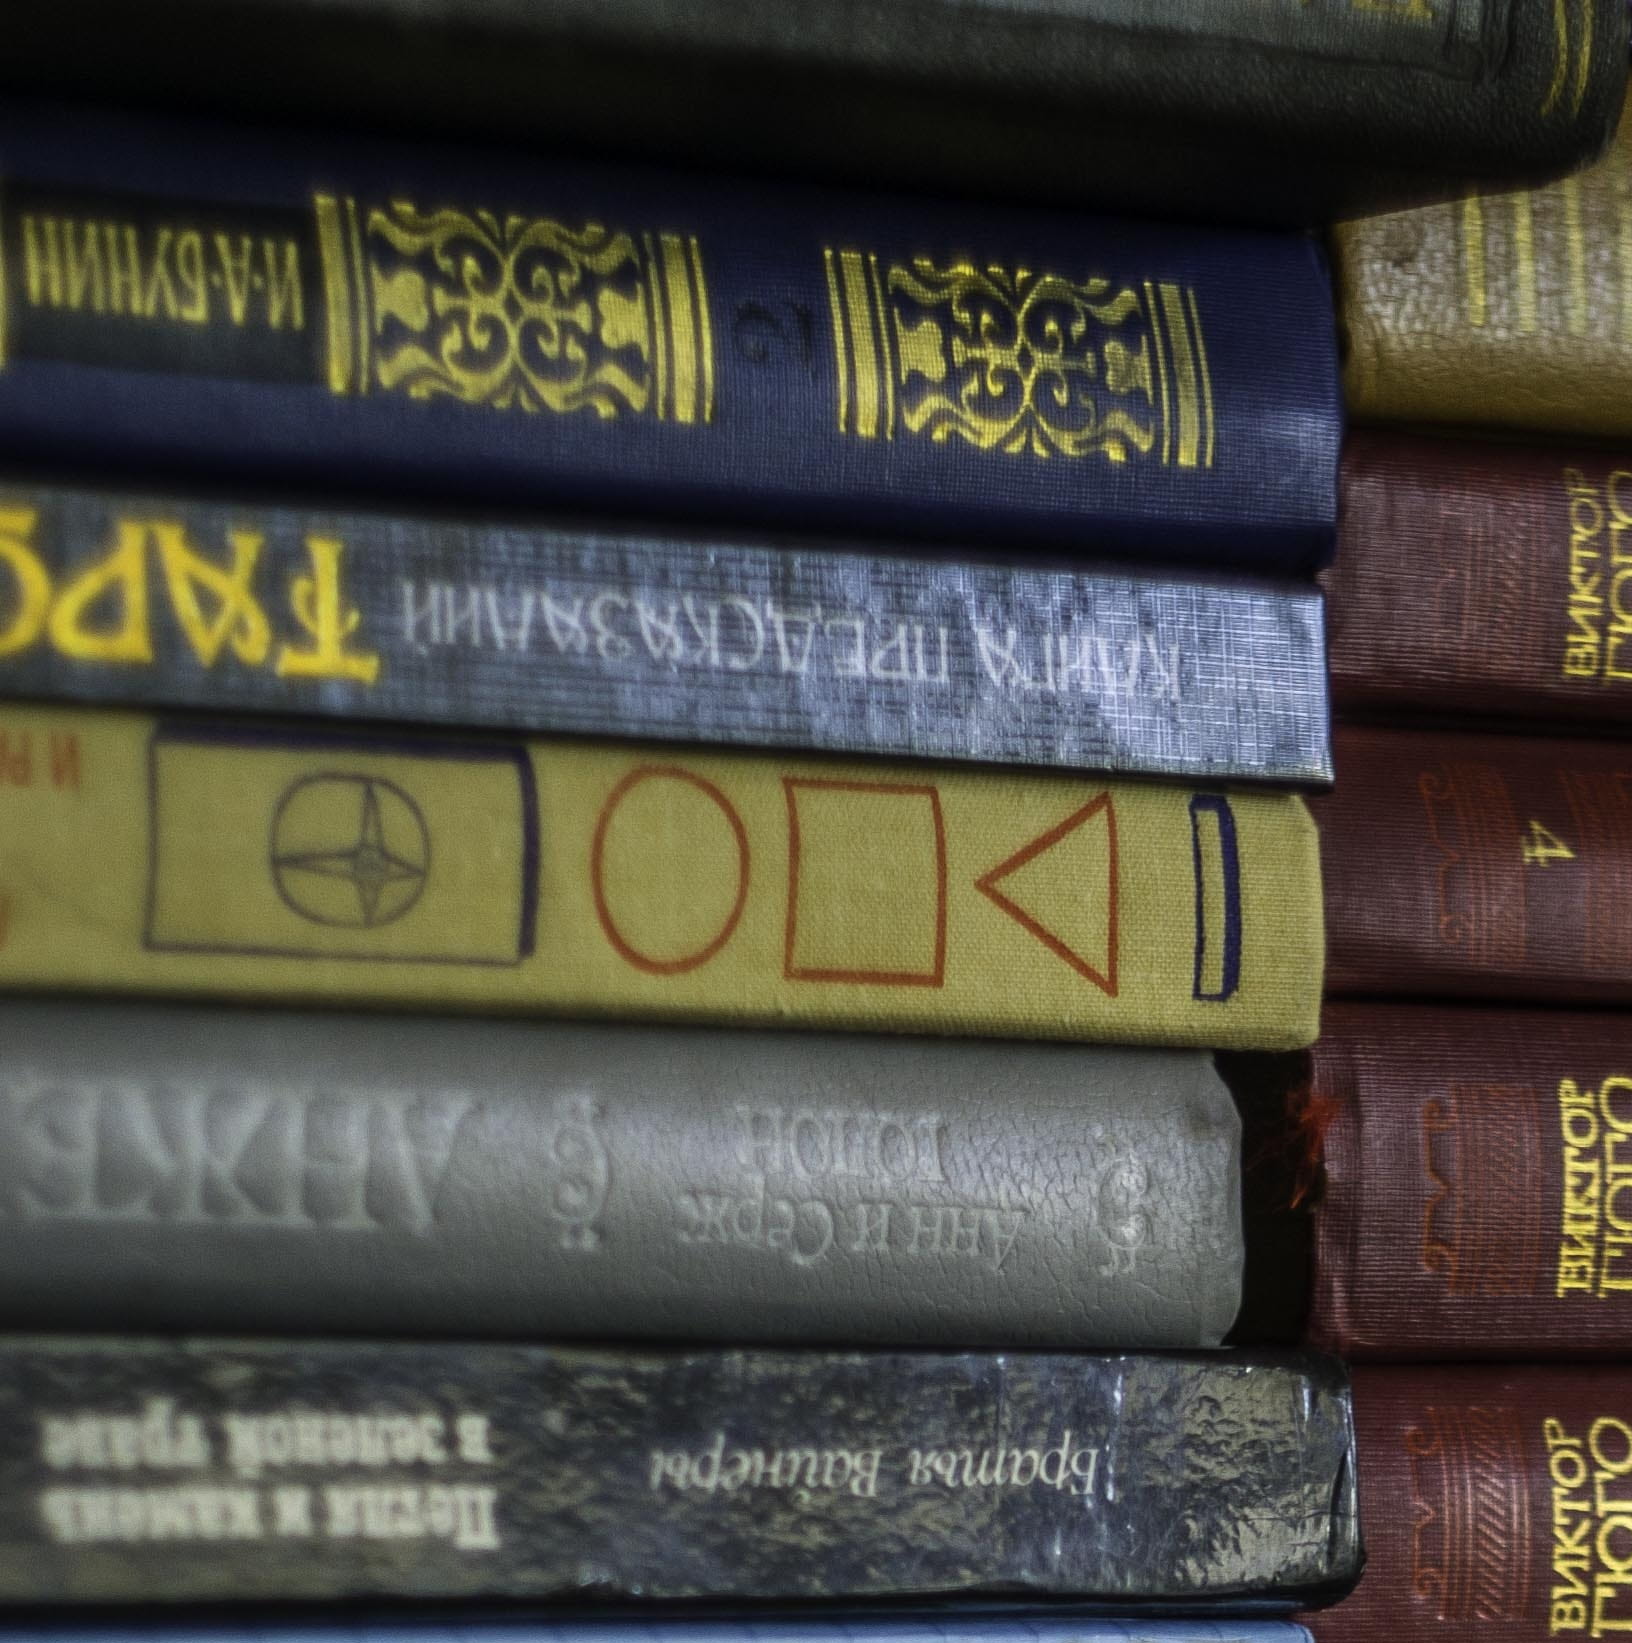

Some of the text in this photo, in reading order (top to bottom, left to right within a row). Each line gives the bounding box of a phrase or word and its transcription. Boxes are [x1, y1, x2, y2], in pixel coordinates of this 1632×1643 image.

[1562, 466, 1604, 681] ВИКТОР
[1522, 819, 1578, 867] 4
[1556, 1077, 1600, 1298] ВИКТОР
[647, 1432, 1098, 1505] Братья Вайнеры
[1546, 1419, 1591, 1635] ВИКТОР
